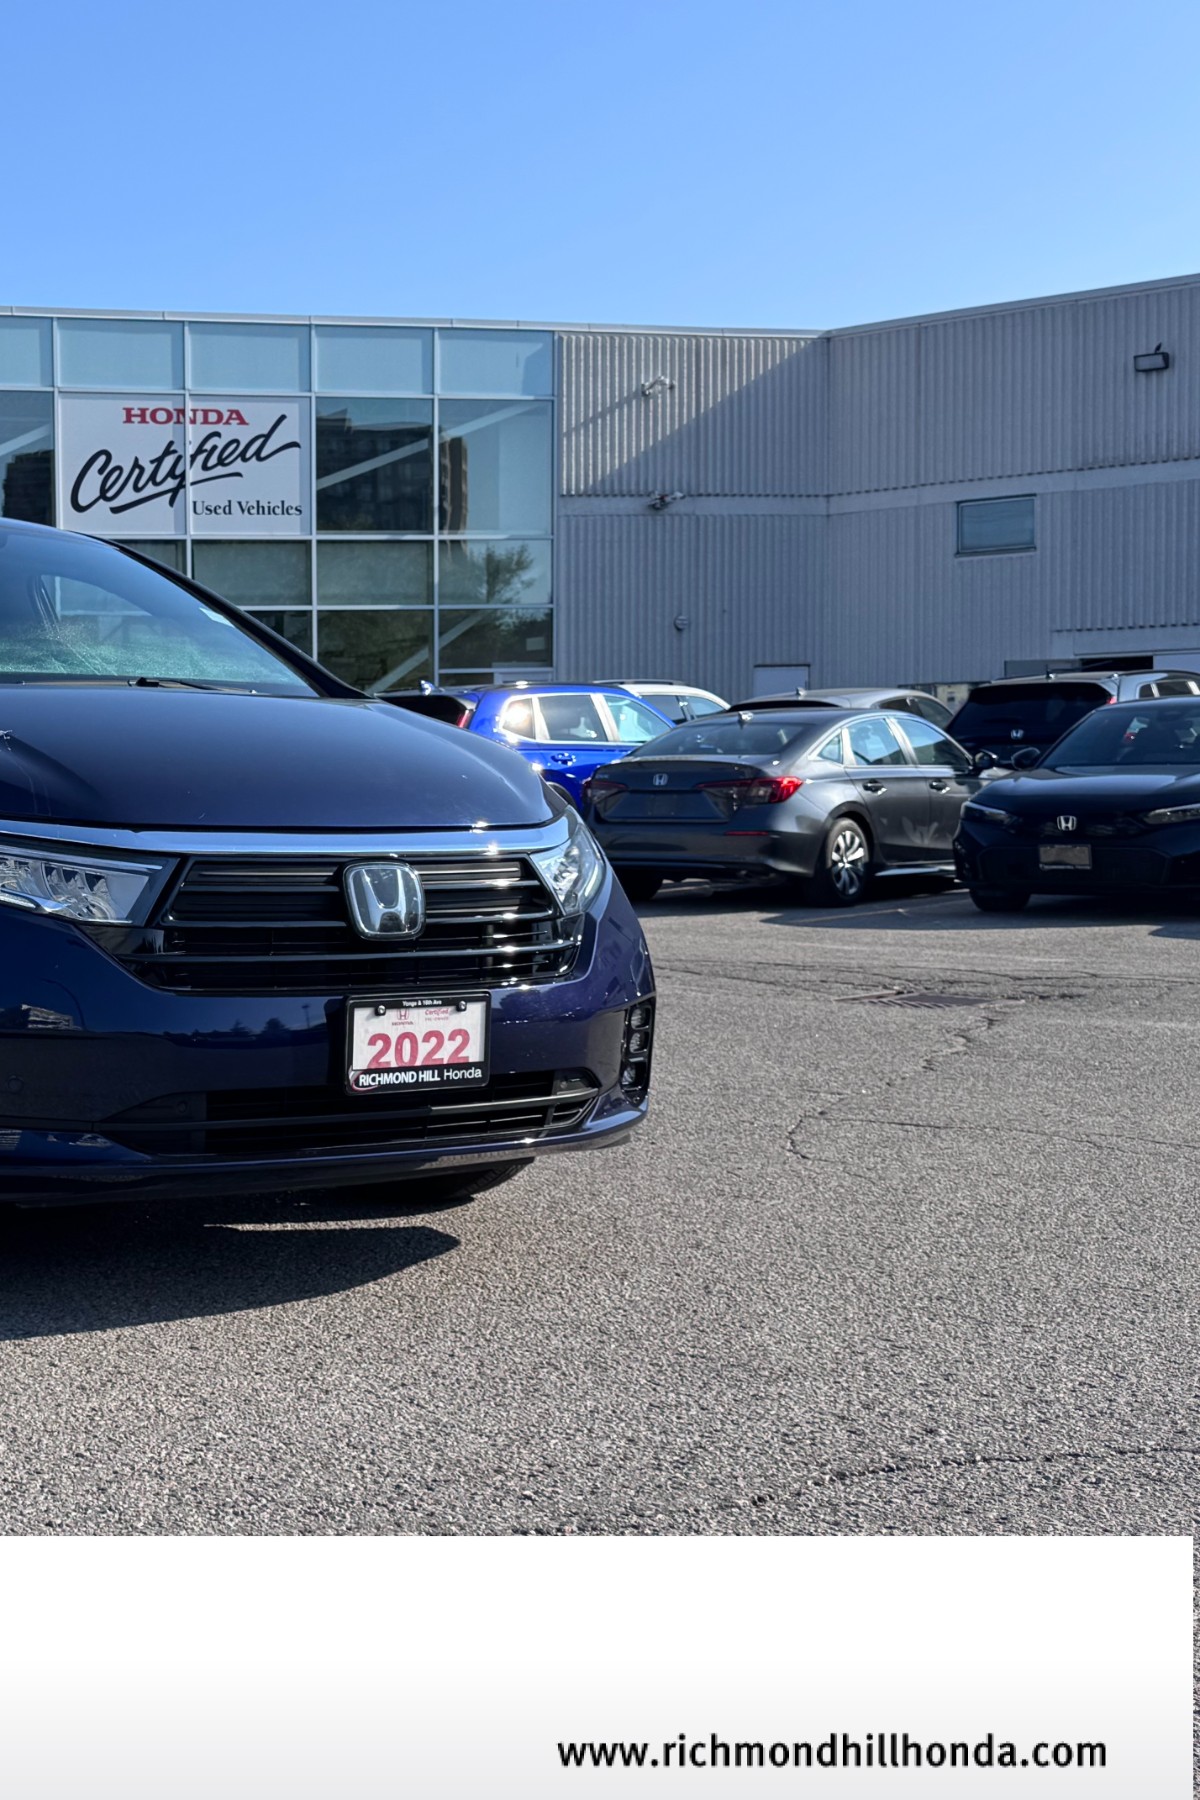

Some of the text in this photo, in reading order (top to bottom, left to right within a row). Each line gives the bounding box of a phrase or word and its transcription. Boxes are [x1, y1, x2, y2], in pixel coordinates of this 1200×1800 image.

[122, 407, 249, 426] HONDA
[70, 414, 301, 513] Certified
[192, 500, 303, 516] Used Vehicles
[367, 1028, 471, 1069] 2022
[359, 1067, 482, 1087] RICHMOND HILL Honda
